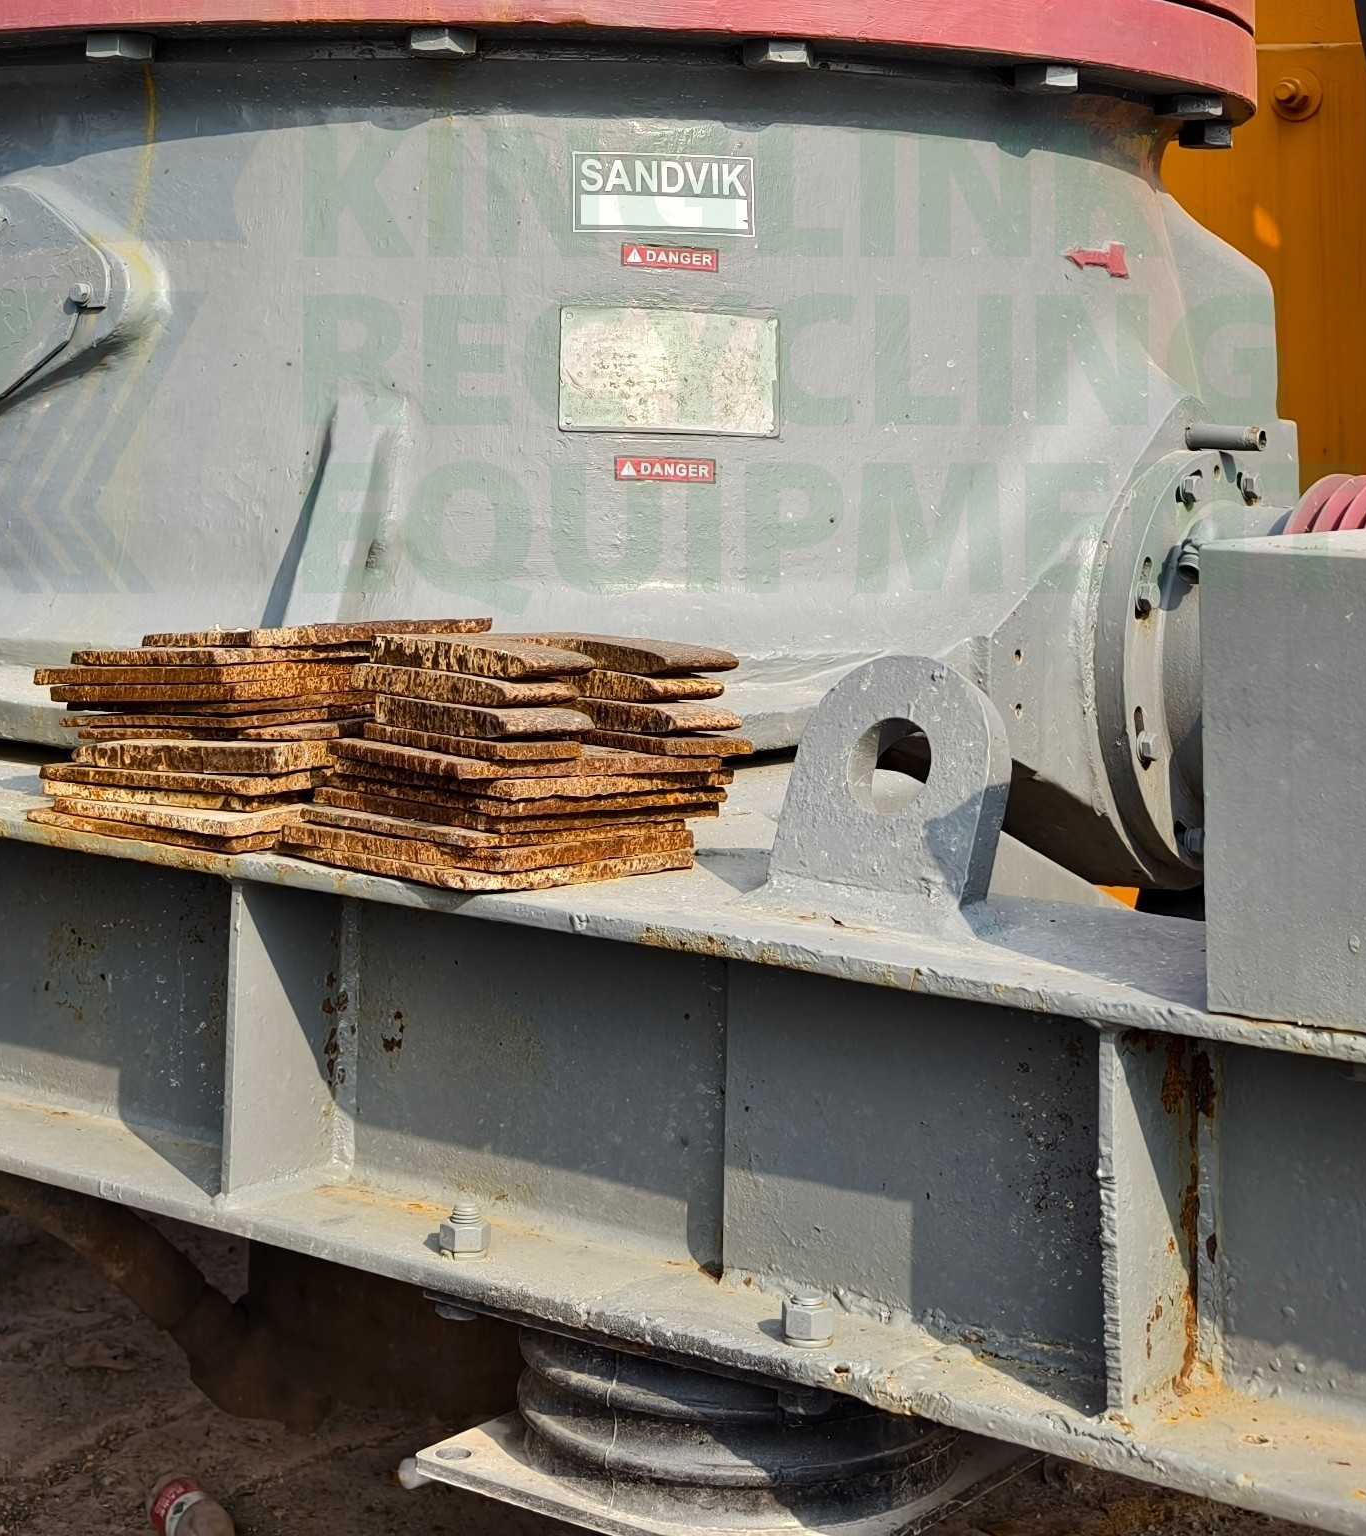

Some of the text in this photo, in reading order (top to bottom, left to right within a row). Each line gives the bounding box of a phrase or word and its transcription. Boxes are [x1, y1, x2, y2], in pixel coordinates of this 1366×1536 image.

[580, 158, 748, 197] SANDVIK
[646, 250, 712, 267] DANGER
[640, 462, 709, 478] DANGER
